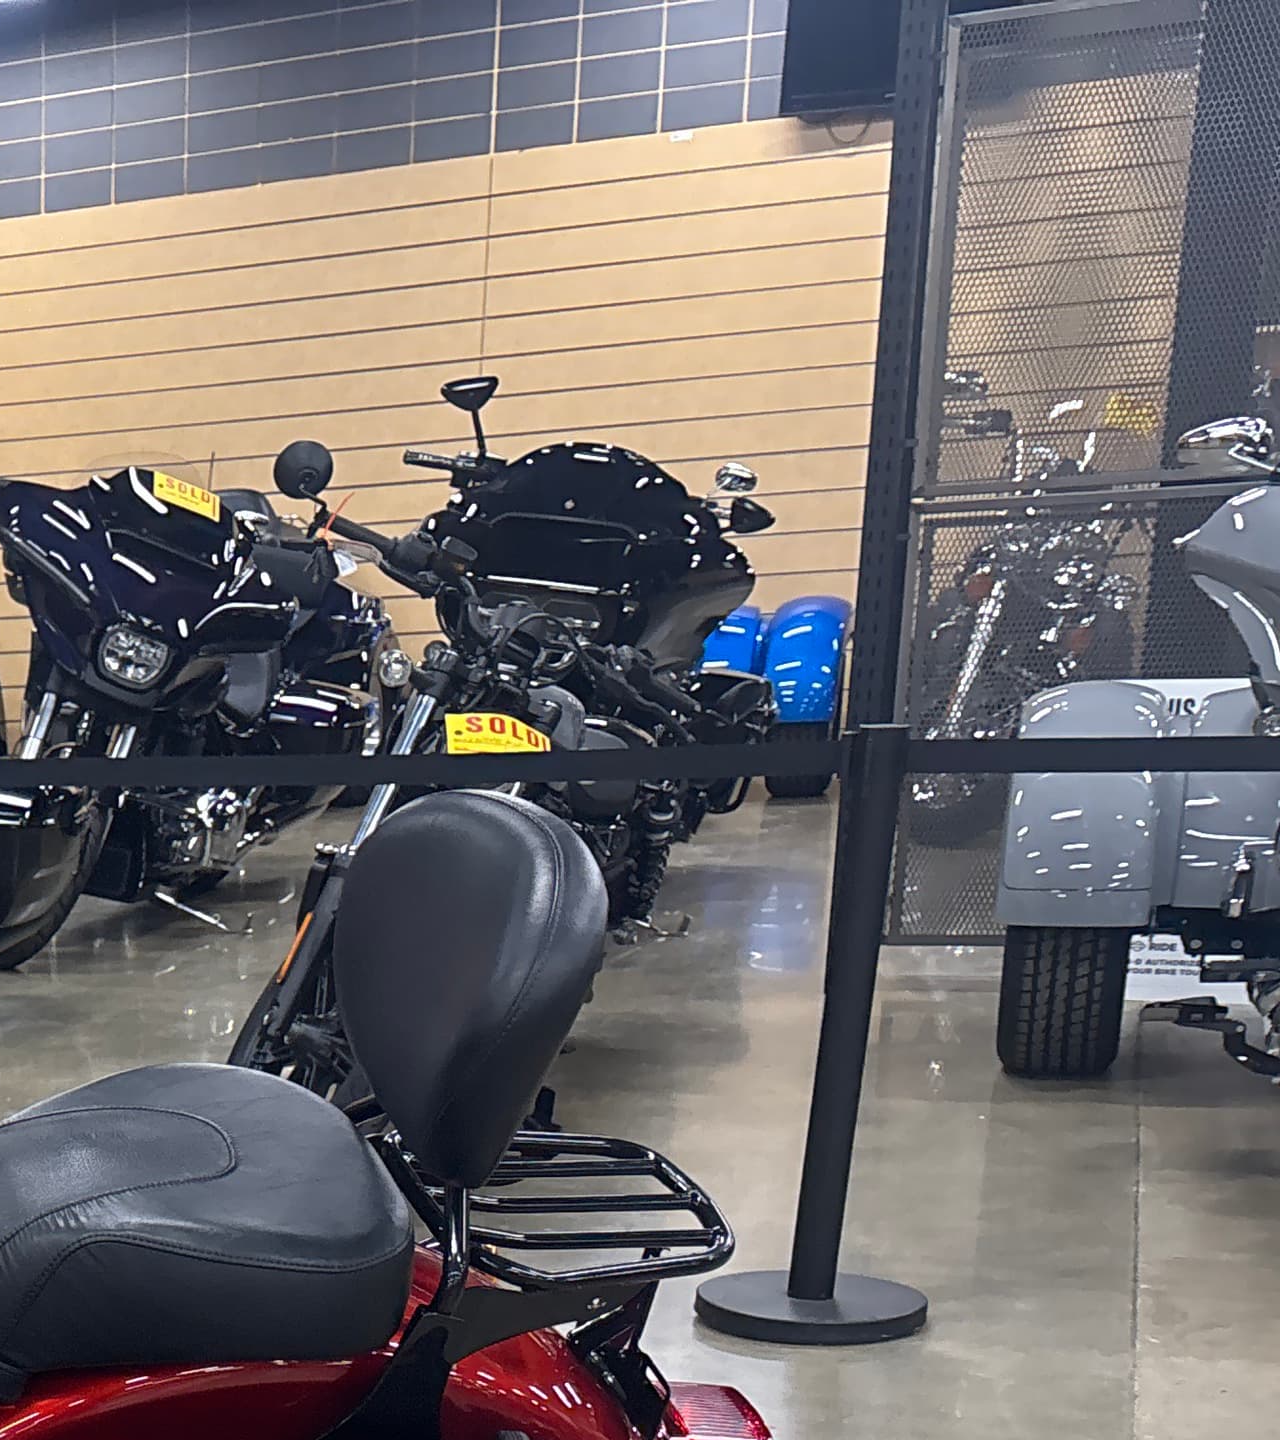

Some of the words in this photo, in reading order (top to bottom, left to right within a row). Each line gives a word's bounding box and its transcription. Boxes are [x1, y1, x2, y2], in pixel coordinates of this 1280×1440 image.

[166, 478, 210, 504] SOLD
[465, 716, 540, 749] SOLD
[1148, 942, 1177, 952] RIDE
